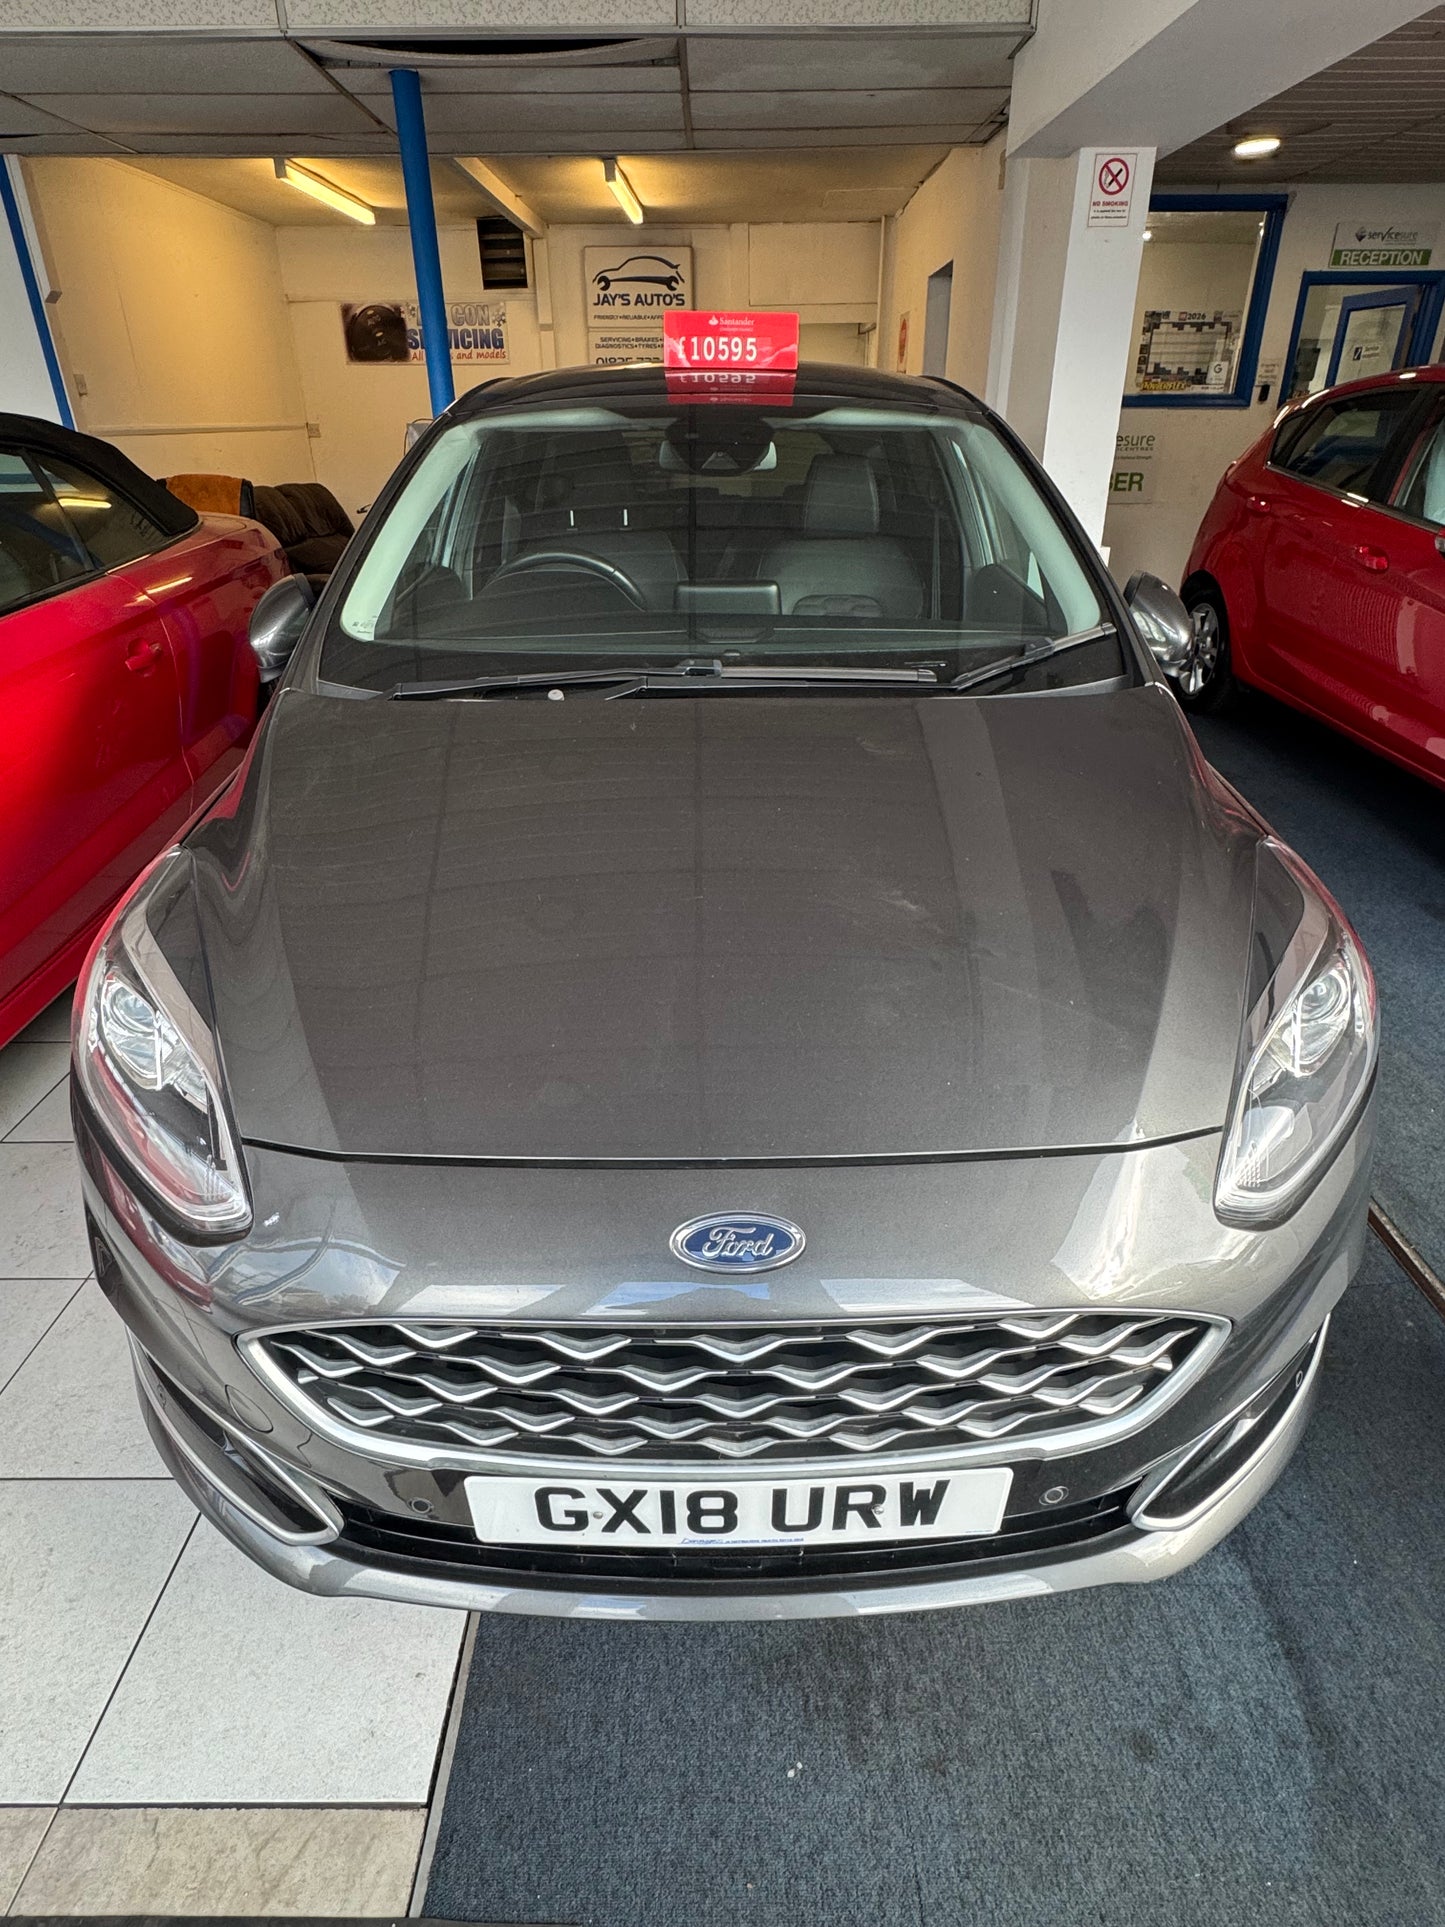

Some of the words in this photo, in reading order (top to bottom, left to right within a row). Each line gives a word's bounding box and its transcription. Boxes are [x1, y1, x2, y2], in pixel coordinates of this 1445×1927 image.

[1340, 251, 1423, 265] RECEPTION
[593, 294, 631, 306] JAY'S
[634, 294, 685, 306] AUTO'S
[451, 304, 491, 327] CON
[719, 317, 755, 326] Santander
[456, 351, 473, 360] and
[476, 349, 506, 360] models
[702, 1226, 775, 1257] Ford
[534, 1486, 738, 1535] GX18
[771, 1479, 951, 1532] URW
